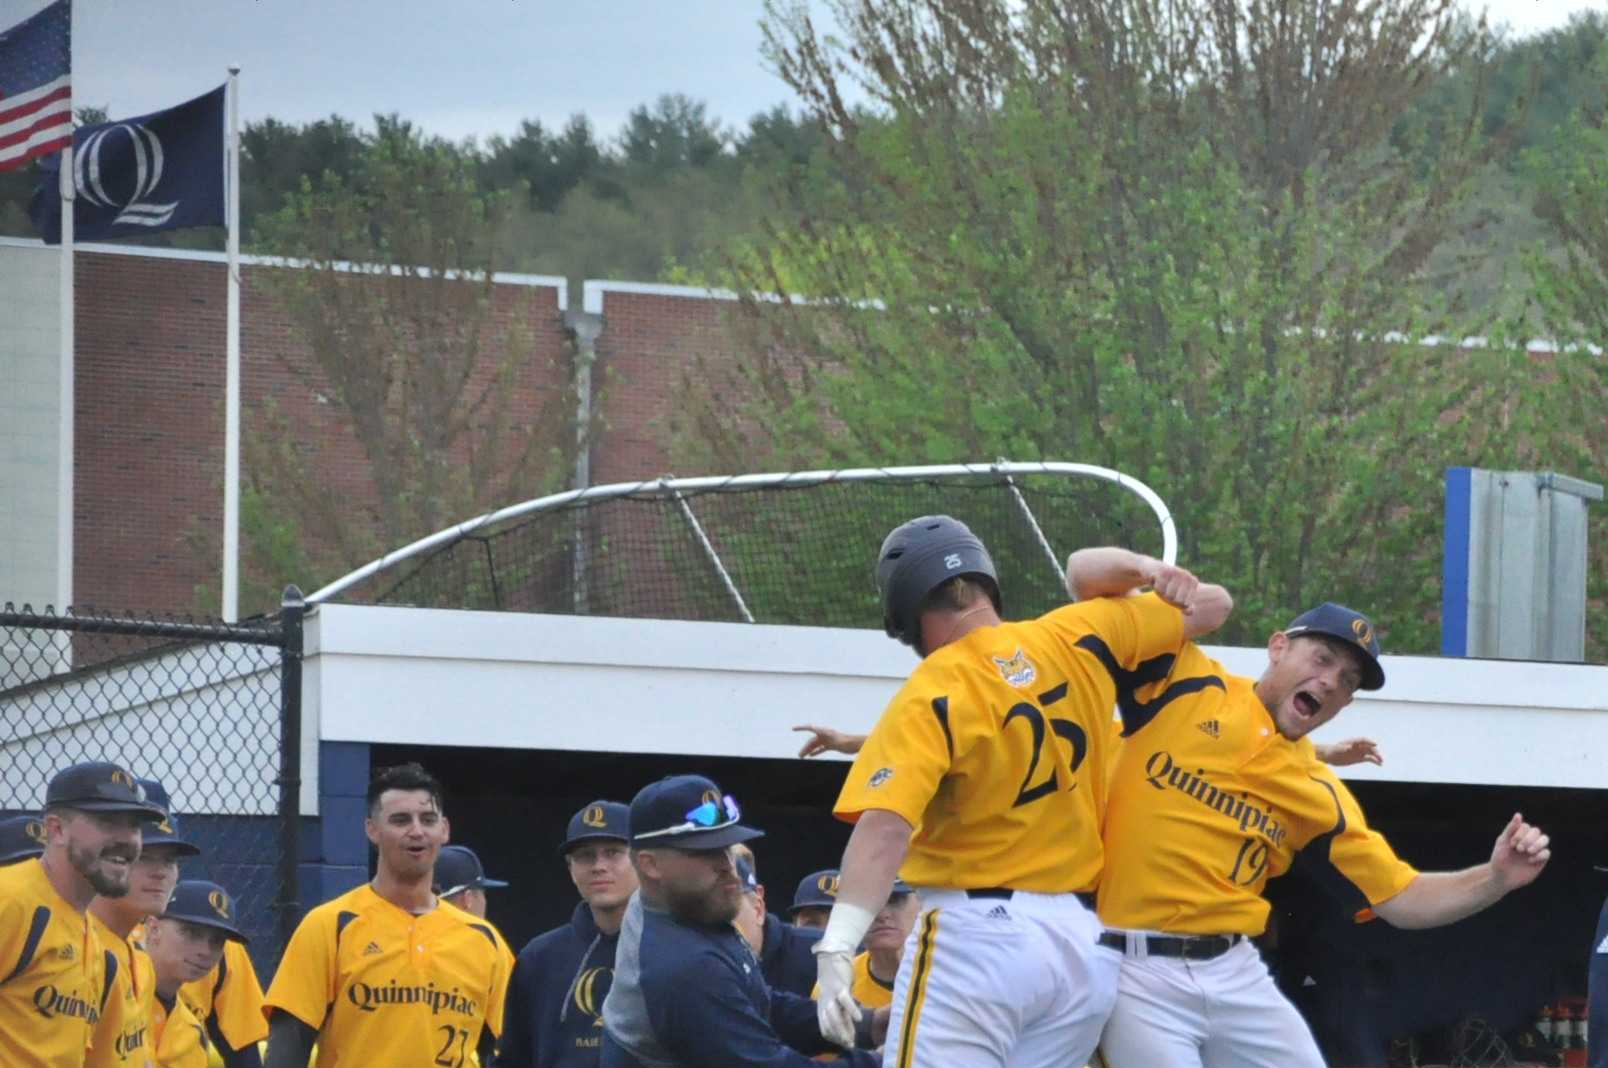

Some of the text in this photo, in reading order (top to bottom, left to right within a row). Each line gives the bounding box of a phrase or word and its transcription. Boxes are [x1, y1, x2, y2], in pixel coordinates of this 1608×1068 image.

[74, 124, 178, 227] Q
[944, 553, 962, 569] 25
[1002, 681, 1086, 808] 25
[1145, 751, 1286, 848] Quinnipiac
[1228, 837, 1269, 887] 19
[348, 978, 476, 1017] Quinnipiac
